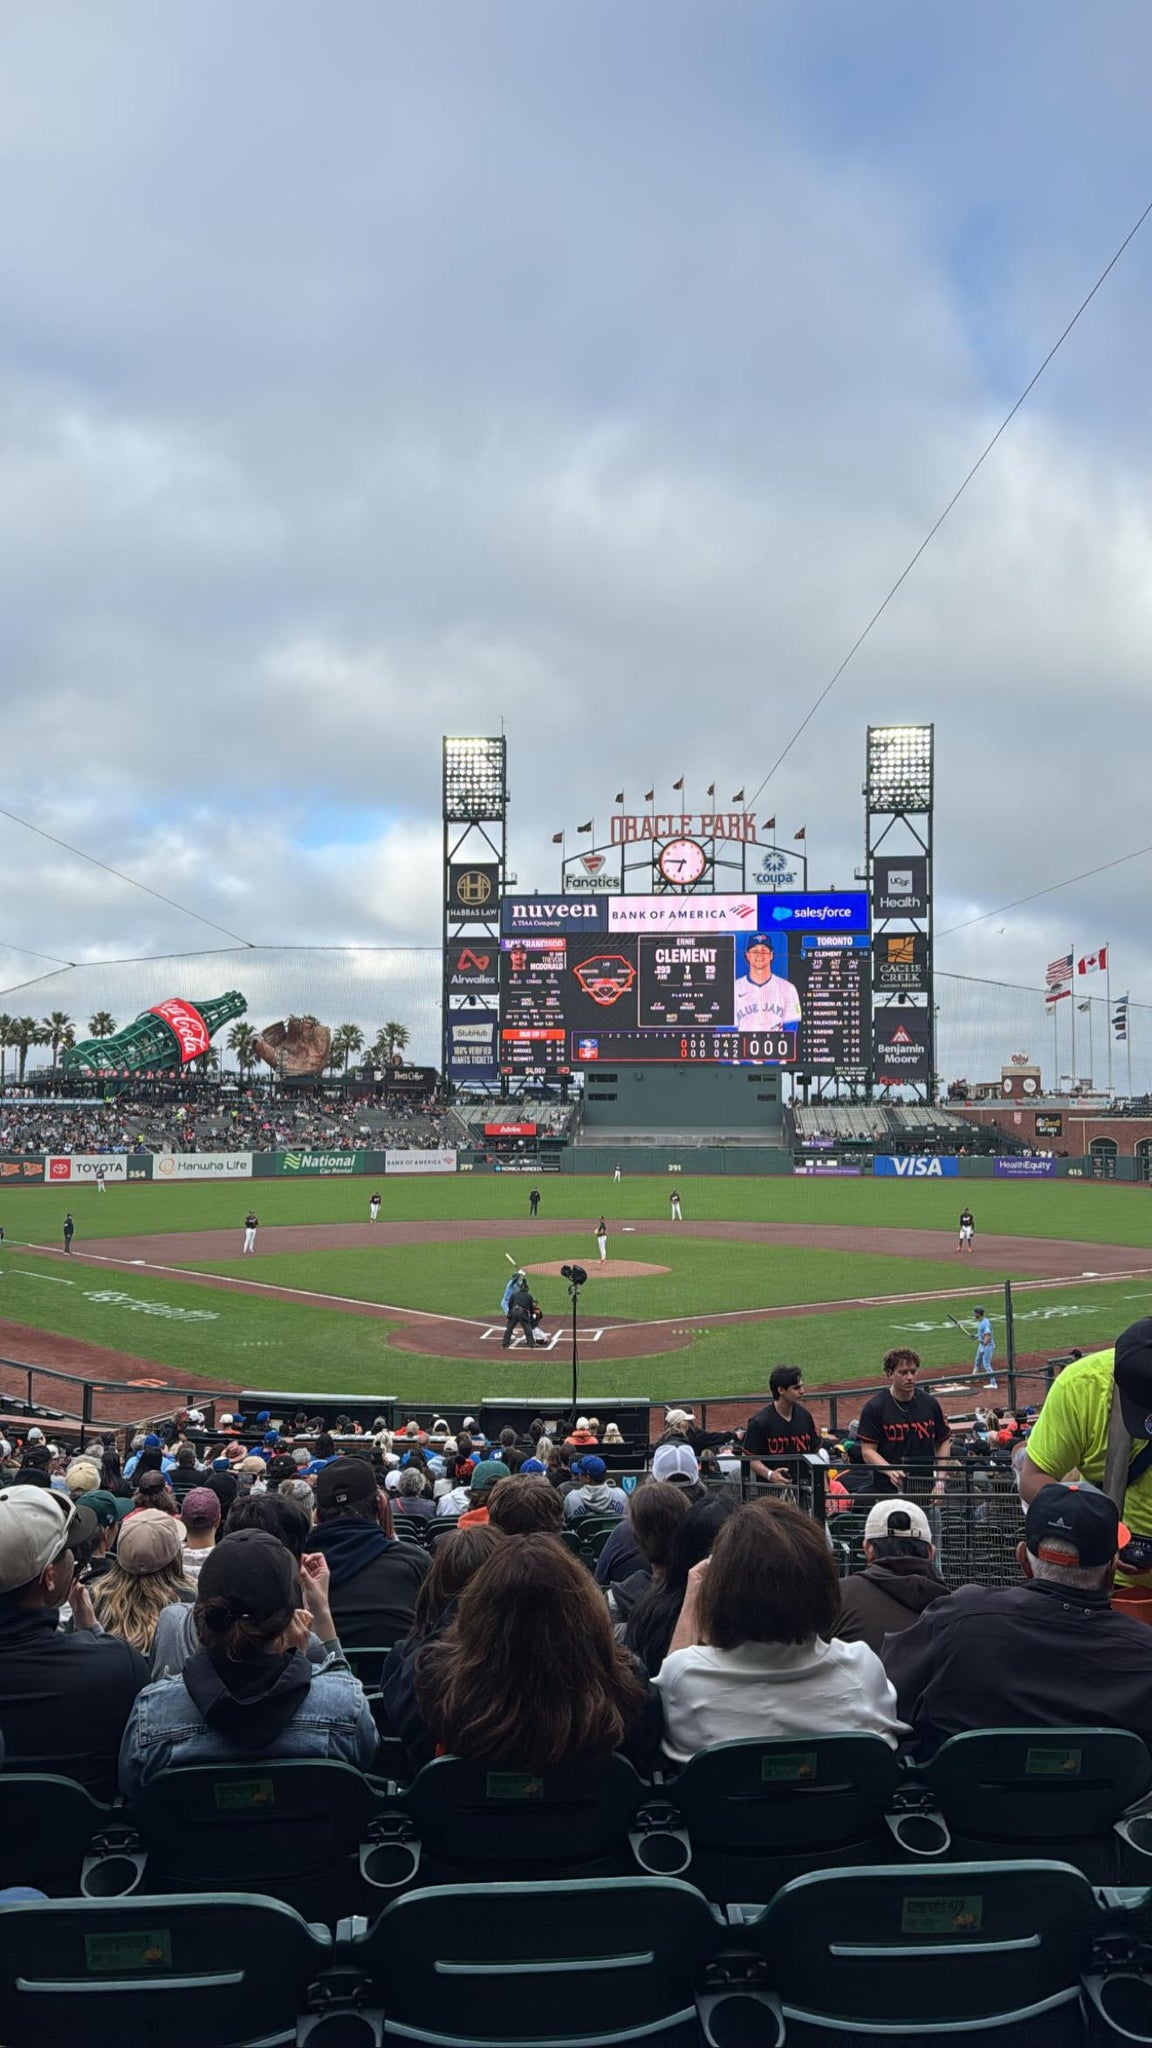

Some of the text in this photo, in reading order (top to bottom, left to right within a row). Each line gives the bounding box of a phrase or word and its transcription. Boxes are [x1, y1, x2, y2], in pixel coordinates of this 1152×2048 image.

[610, 813, 758, 845] ORACLE PARK
[565, 875, 620, 888] Fanatics
[756, 872, 793, 886] coupa
[880, 896, 920, 908] Health
[512, 904, 598, 918] nuveen
[612, 910, 726, 919] BANK OF AMERICA
[794, 907, 852, 920] salesforce
[523, 940, 563, 948] FRANCISCO
[677, 938, 695, 946] ERNIE
[817, 936, 853, 946] TORONTO
[655, 949, 717, 963] CLEMENT
[685, 965, 691, 974] 7
[880, 964, 922, 973] CACHE
[451, 974, 496, 984] Airwallex
[881, 973, 920, 982] CREEK
[159, 1002, 206, 1054] ca-Cola
[457, 1029, 487, 1037] StubHub
[681, 1040, 738, 1048] 0 0 0 0 4 2
[750, 1040, 787, 1055] 0 0 0
[453, 1046, 492, 1055] 100% VERIFIED
[681, 1049, 738, 1058] 0 0 0 0 4 2
[878, 1044, 925, 1055] Benjamin
[452, 1056, 494, 1064] GIANTS TICKETS
[885, 1055, 918, 1064] Moore
[178, 1160, 247, 1171] Hanwha Life
[301, 1154, 356, 1167] National
[999, 1160, 1051, 1171] HealthEquity
[76, 1163, 123, 1173] TOYOTA
[668, 1164, 681, 1172] 391
[890, 1157, 942, 1176] VISA
[128, 1170, 146, 1178] 354
[1068, 1168, 1082, 1176] 415
